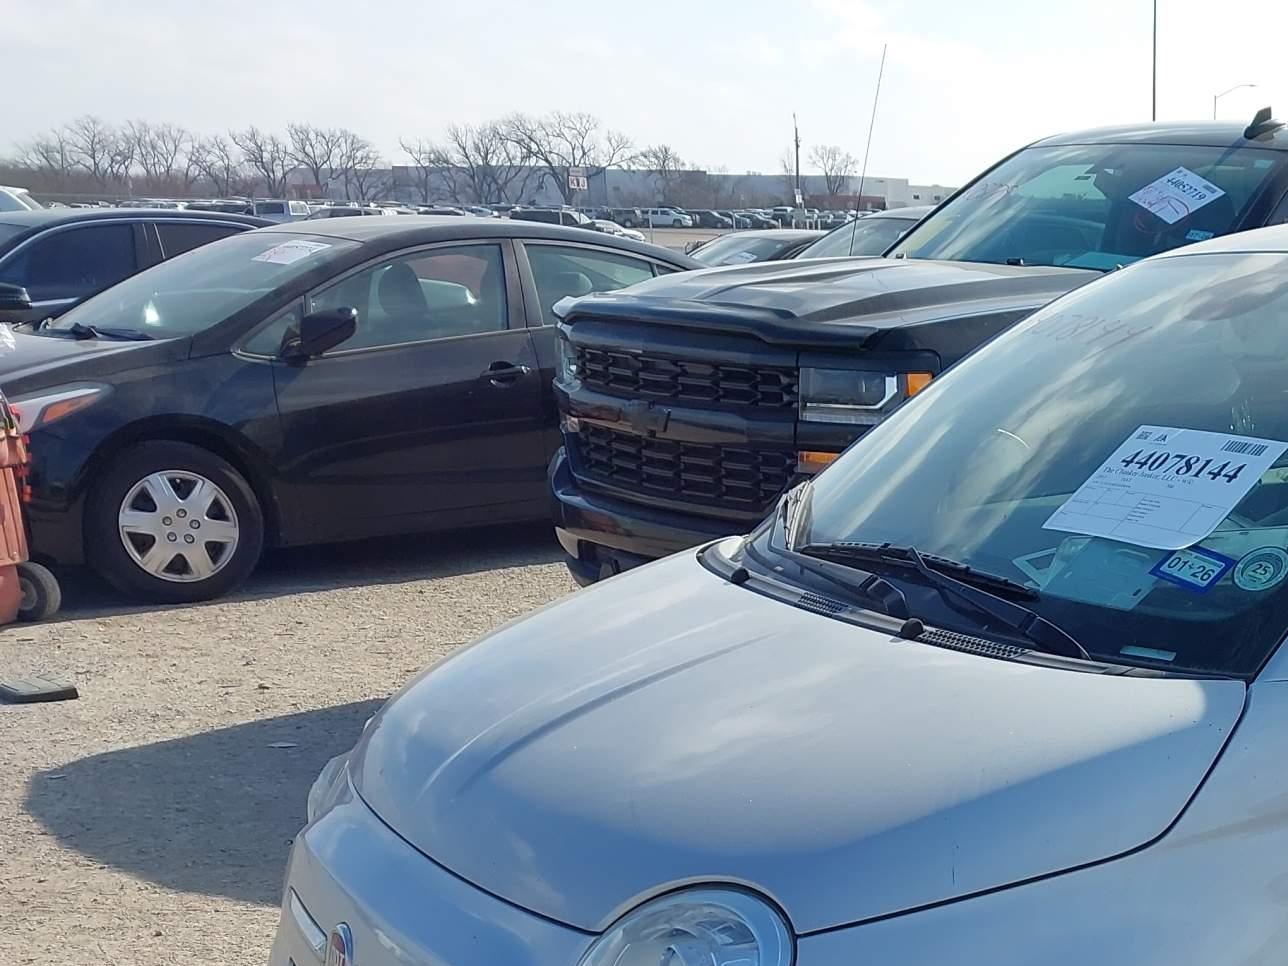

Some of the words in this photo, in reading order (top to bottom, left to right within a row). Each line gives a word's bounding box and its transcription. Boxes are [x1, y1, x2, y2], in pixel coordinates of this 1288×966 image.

[1120, 448, 1248, 483] 44078144
[1168, 556, 1189, 572] 01
[1190, 565, 1215, 582] 26
[1252, 563, 1271, 576] 25
